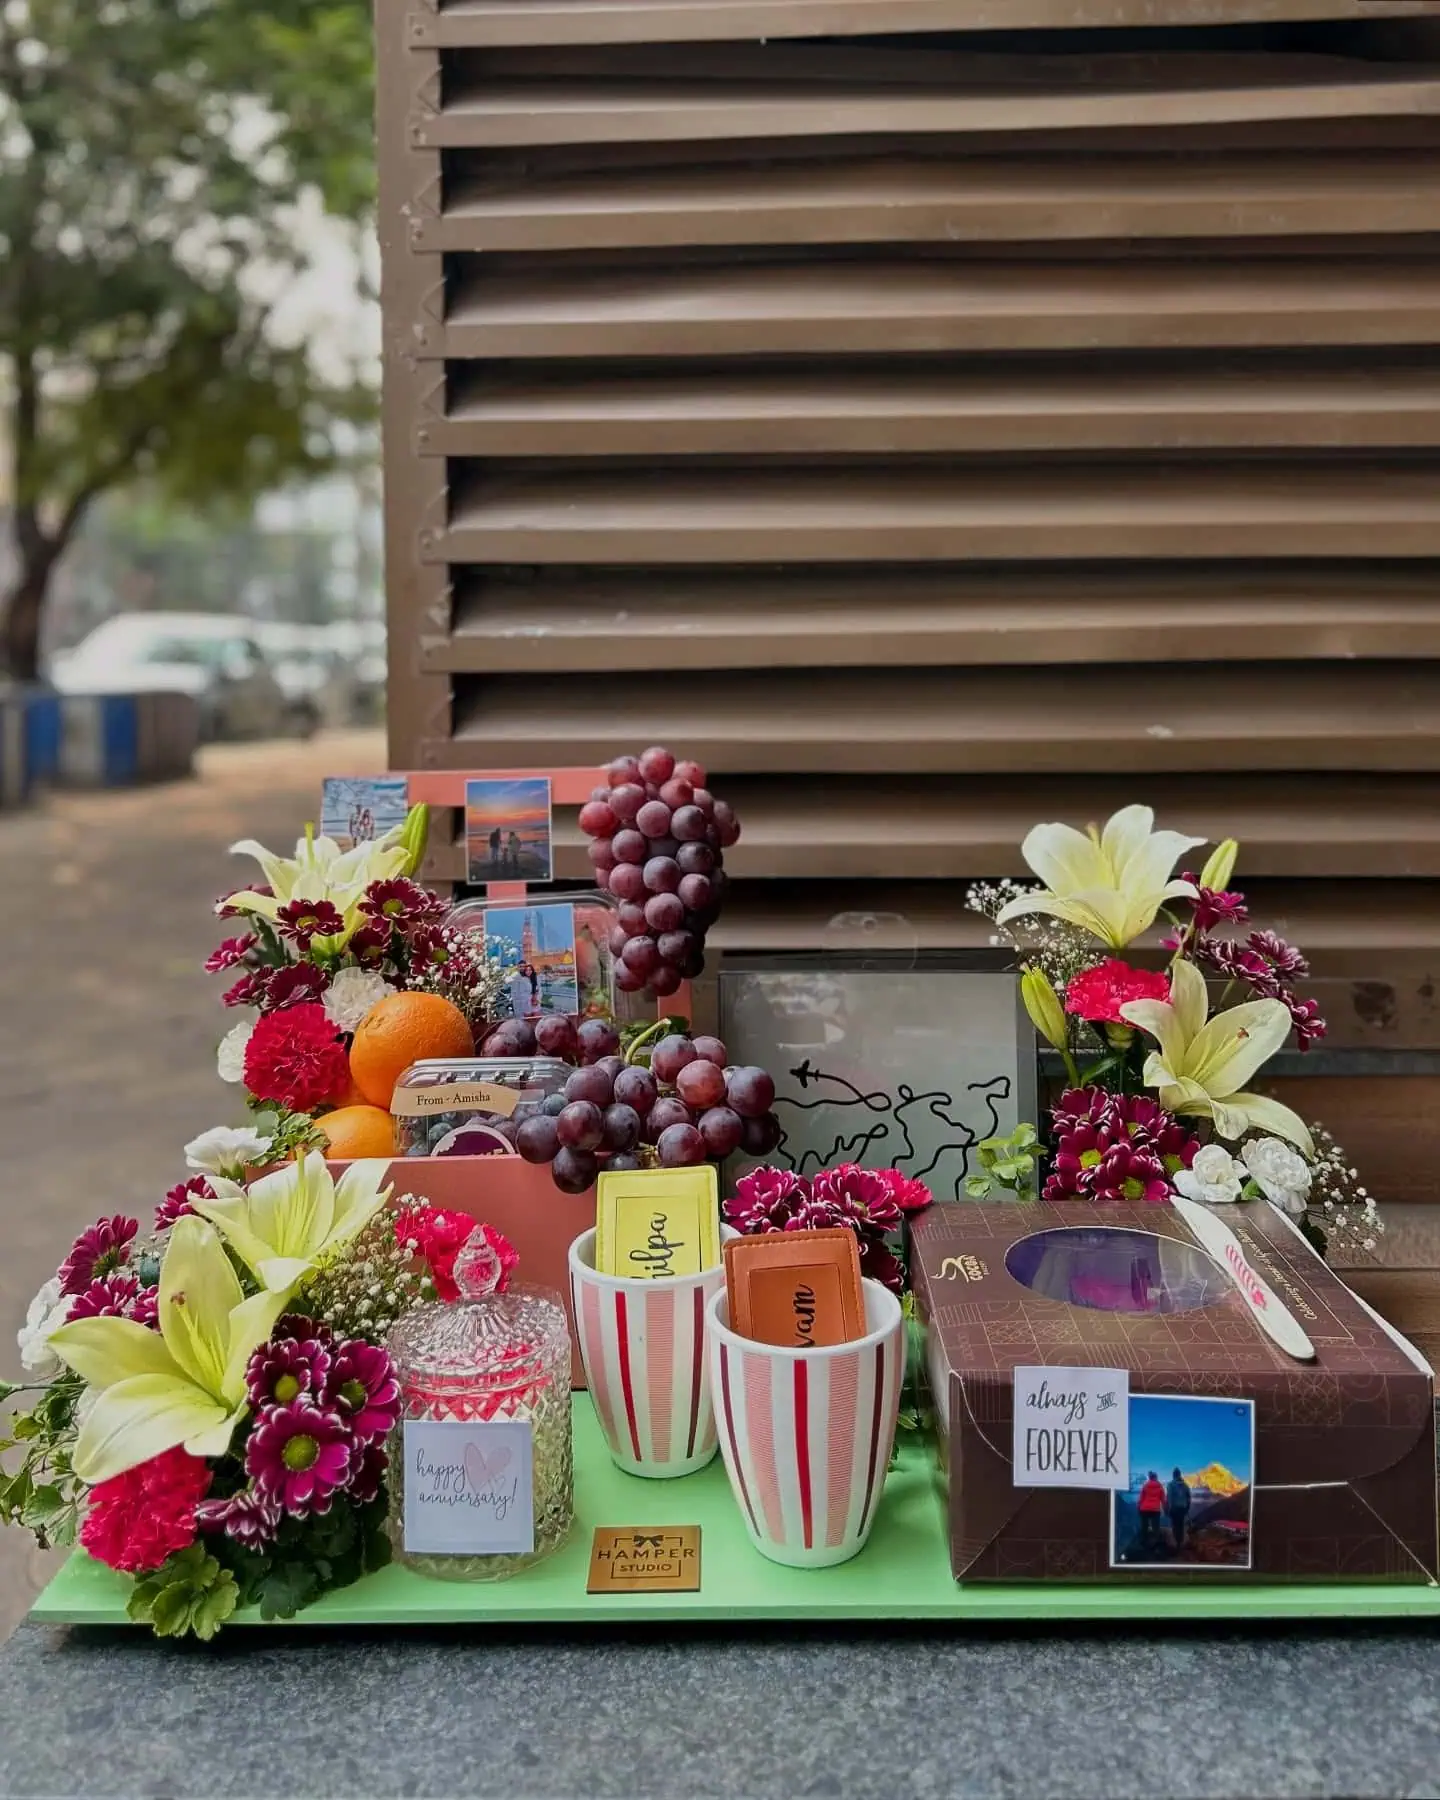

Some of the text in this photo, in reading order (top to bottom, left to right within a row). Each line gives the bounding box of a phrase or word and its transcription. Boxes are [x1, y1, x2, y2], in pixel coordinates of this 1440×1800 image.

[416, 1094, 443, 1106] From
[452, 1091, 490, 1104] Amisha
[1026, 1380, 1088, 1424] always
[1026, 1427, 1120, 1474] FOREVER
[416, 1448, 466, 1493] happy
[597, 1548, 696, 1559] HAMPER
[619, 1563, 672, 1572] STUDIO
